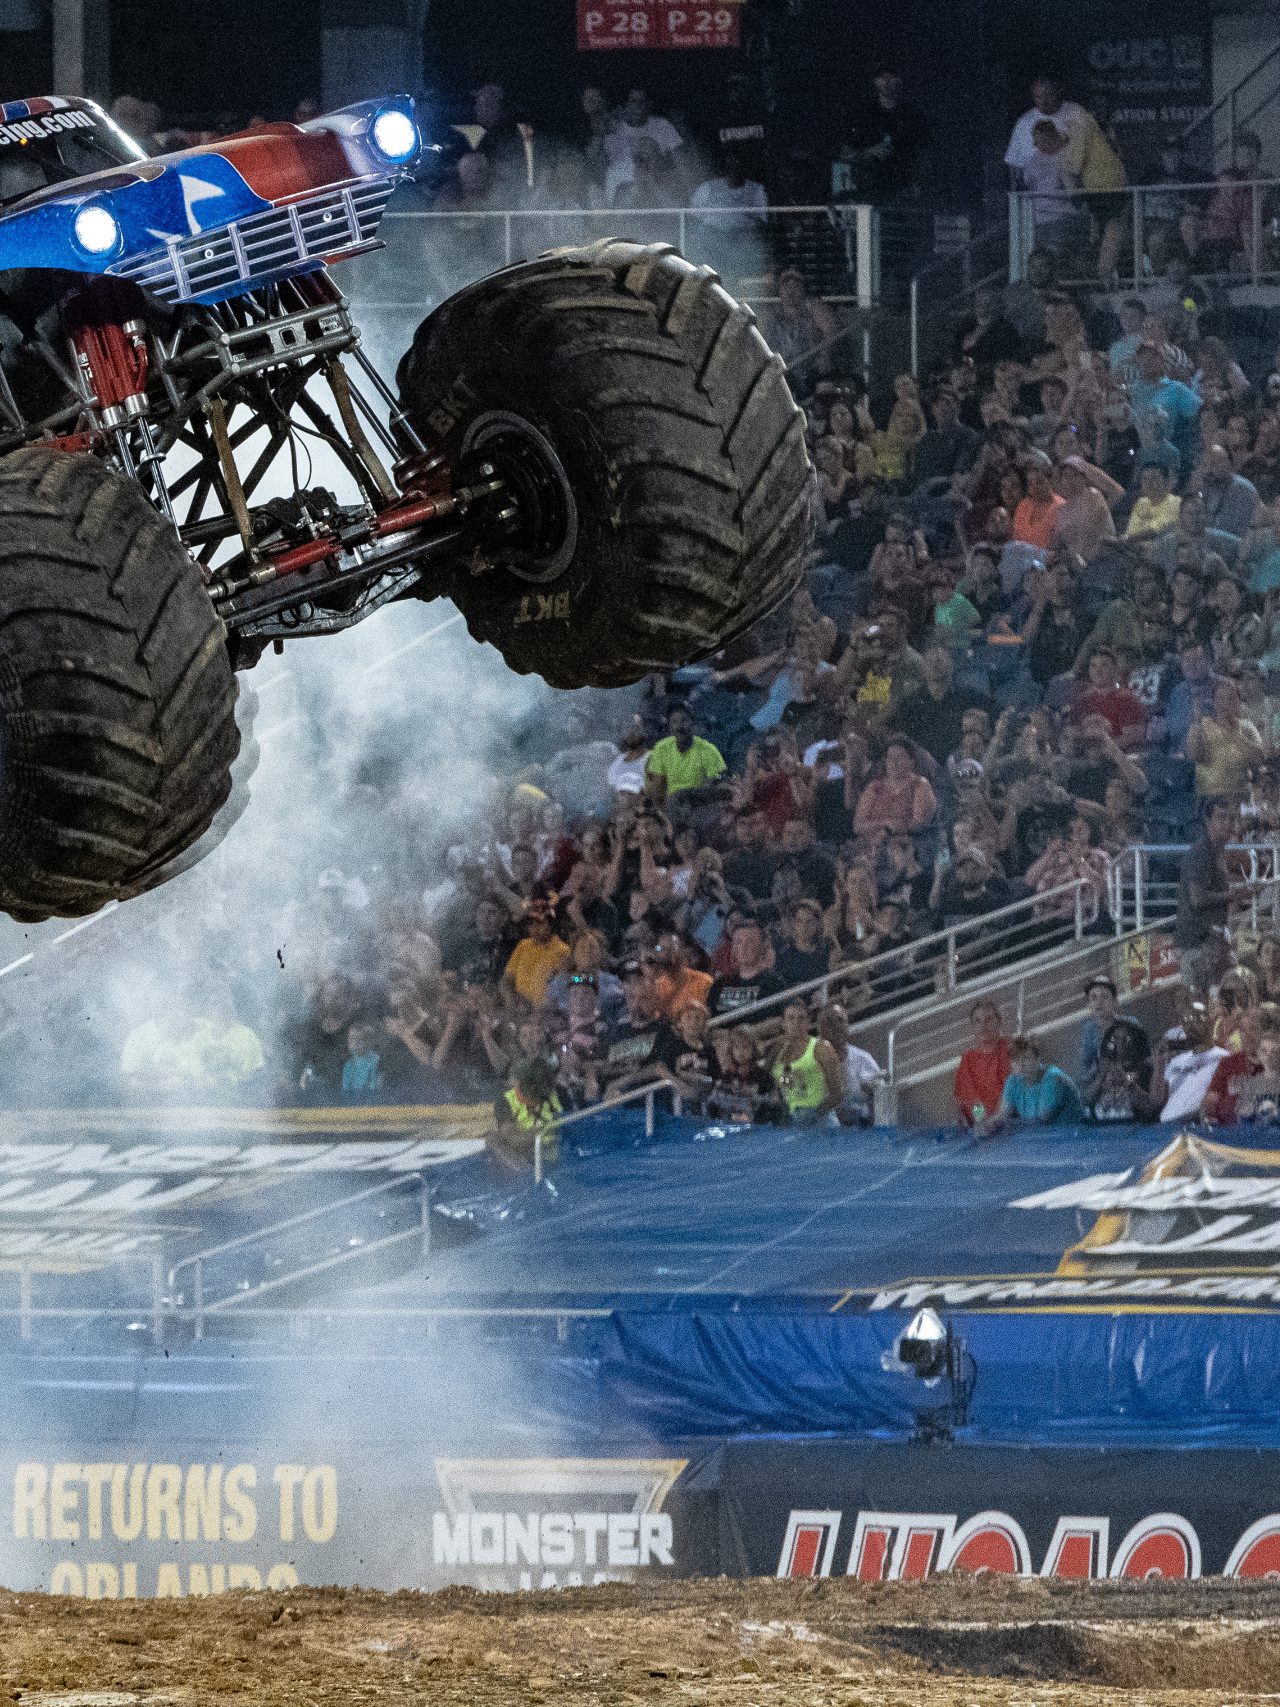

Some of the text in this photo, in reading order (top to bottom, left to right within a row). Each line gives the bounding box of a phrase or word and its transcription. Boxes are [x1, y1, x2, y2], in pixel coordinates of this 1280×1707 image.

[585, 10, 649, 32] P 28
[668, 10, 733, 33] P 29
[14, 1463, 339, 1543] RETURNS TO
[432, 1512, 675, 1566] MONSTER
